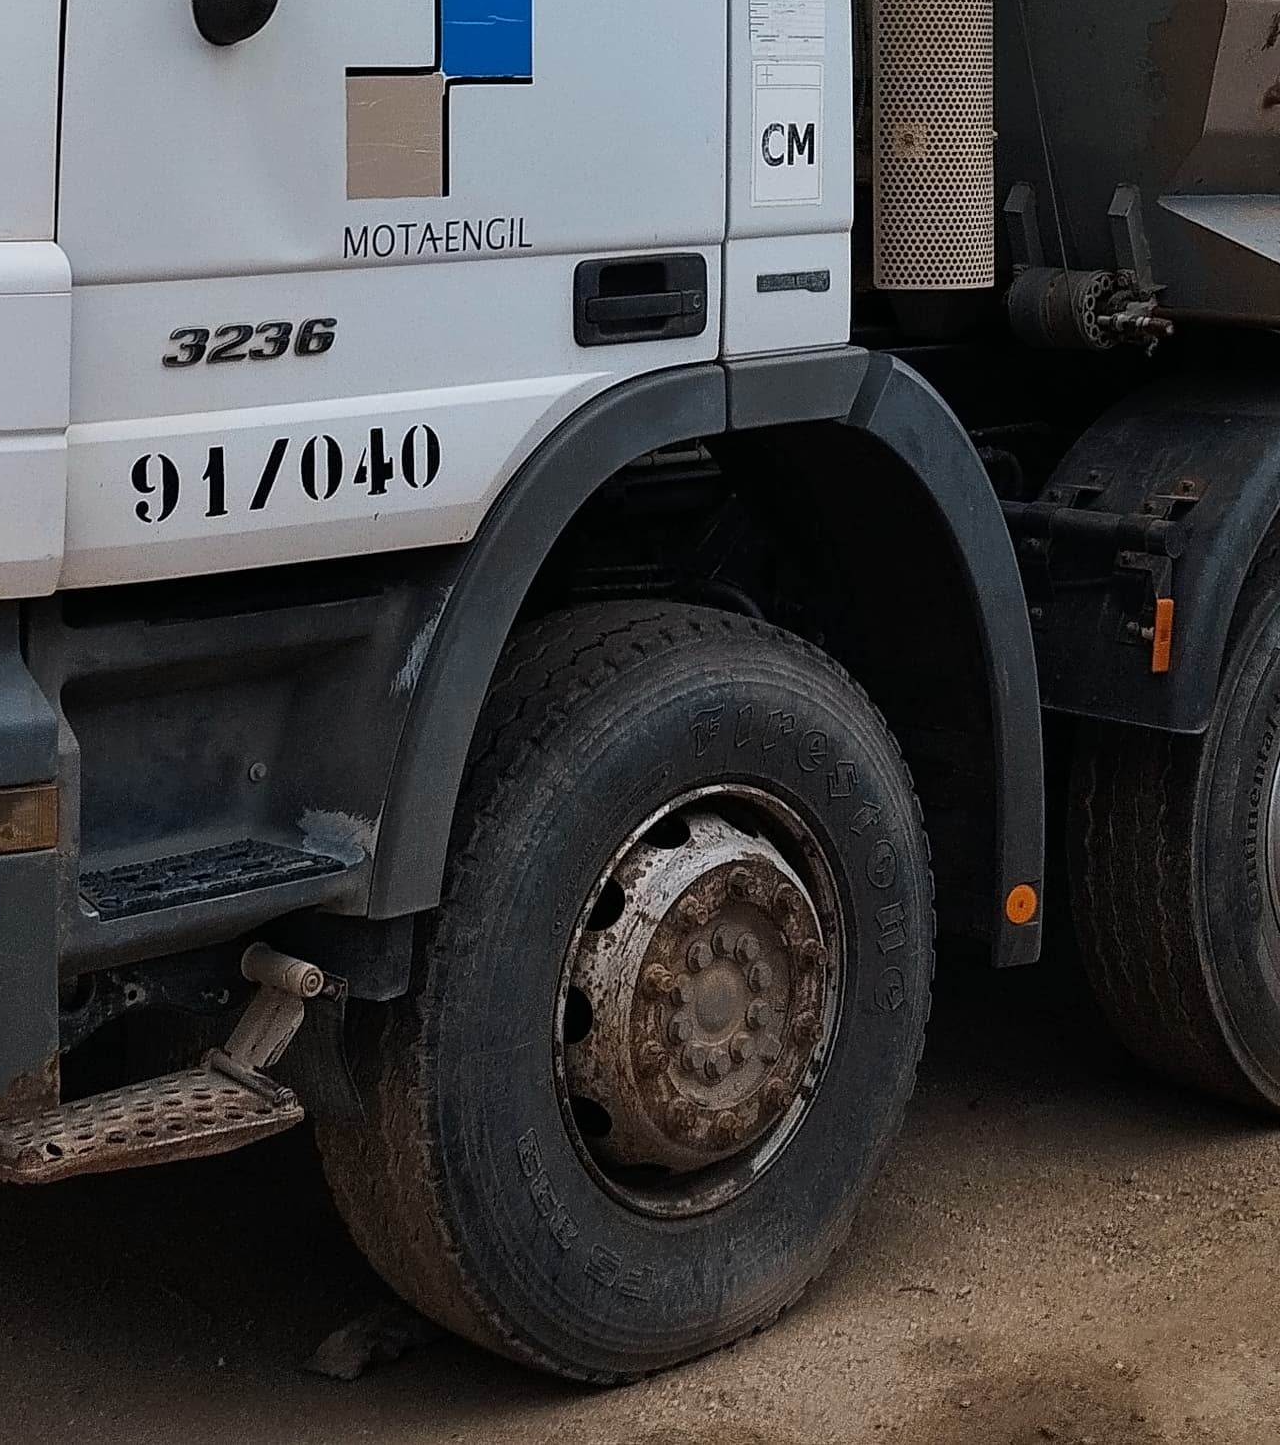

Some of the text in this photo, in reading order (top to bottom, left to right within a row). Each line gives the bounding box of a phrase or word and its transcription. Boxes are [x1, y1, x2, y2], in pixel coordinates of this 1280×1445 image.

[761, 123, 816, 167] CM
[162, 317, 339, 369] 3236
[130, 423, 442, 524] 91/040
[689, 703, 908, 1013] Firestone
